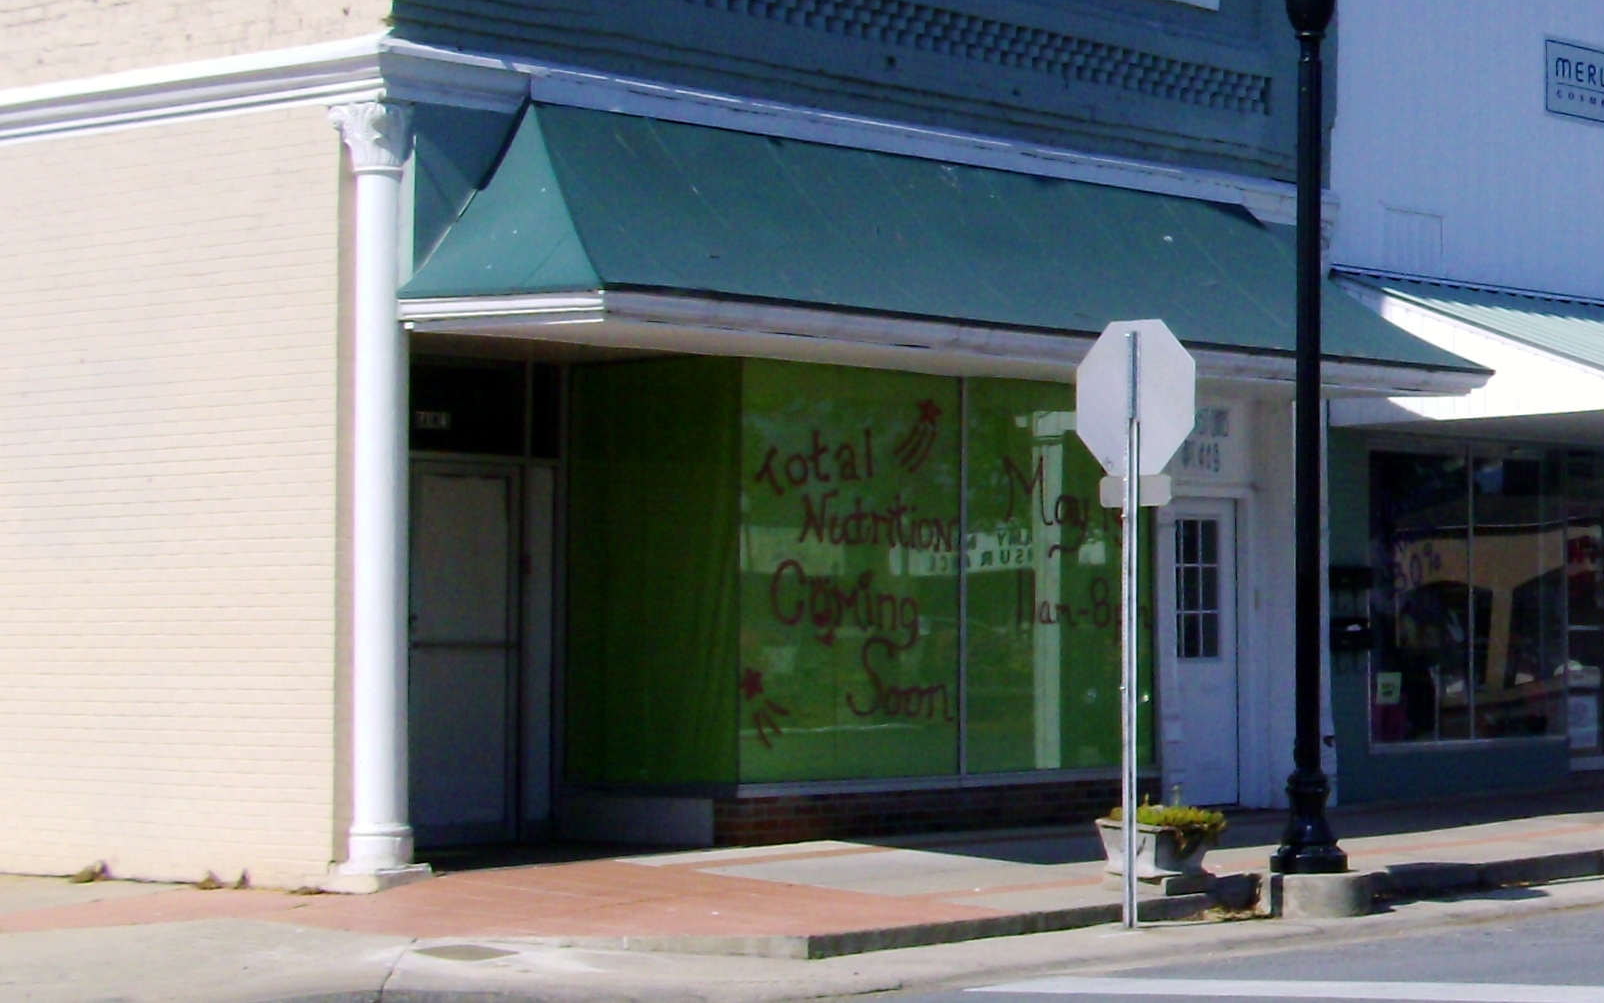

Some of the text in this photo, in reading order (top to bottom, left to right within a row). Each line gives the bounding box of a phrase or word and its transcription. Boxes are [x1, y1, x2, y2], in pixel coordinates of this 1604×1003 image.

[755, 427, 874, 496] Total
[1003, 454, 1090, 559] May
[846, 636, 954, 722] Soon
